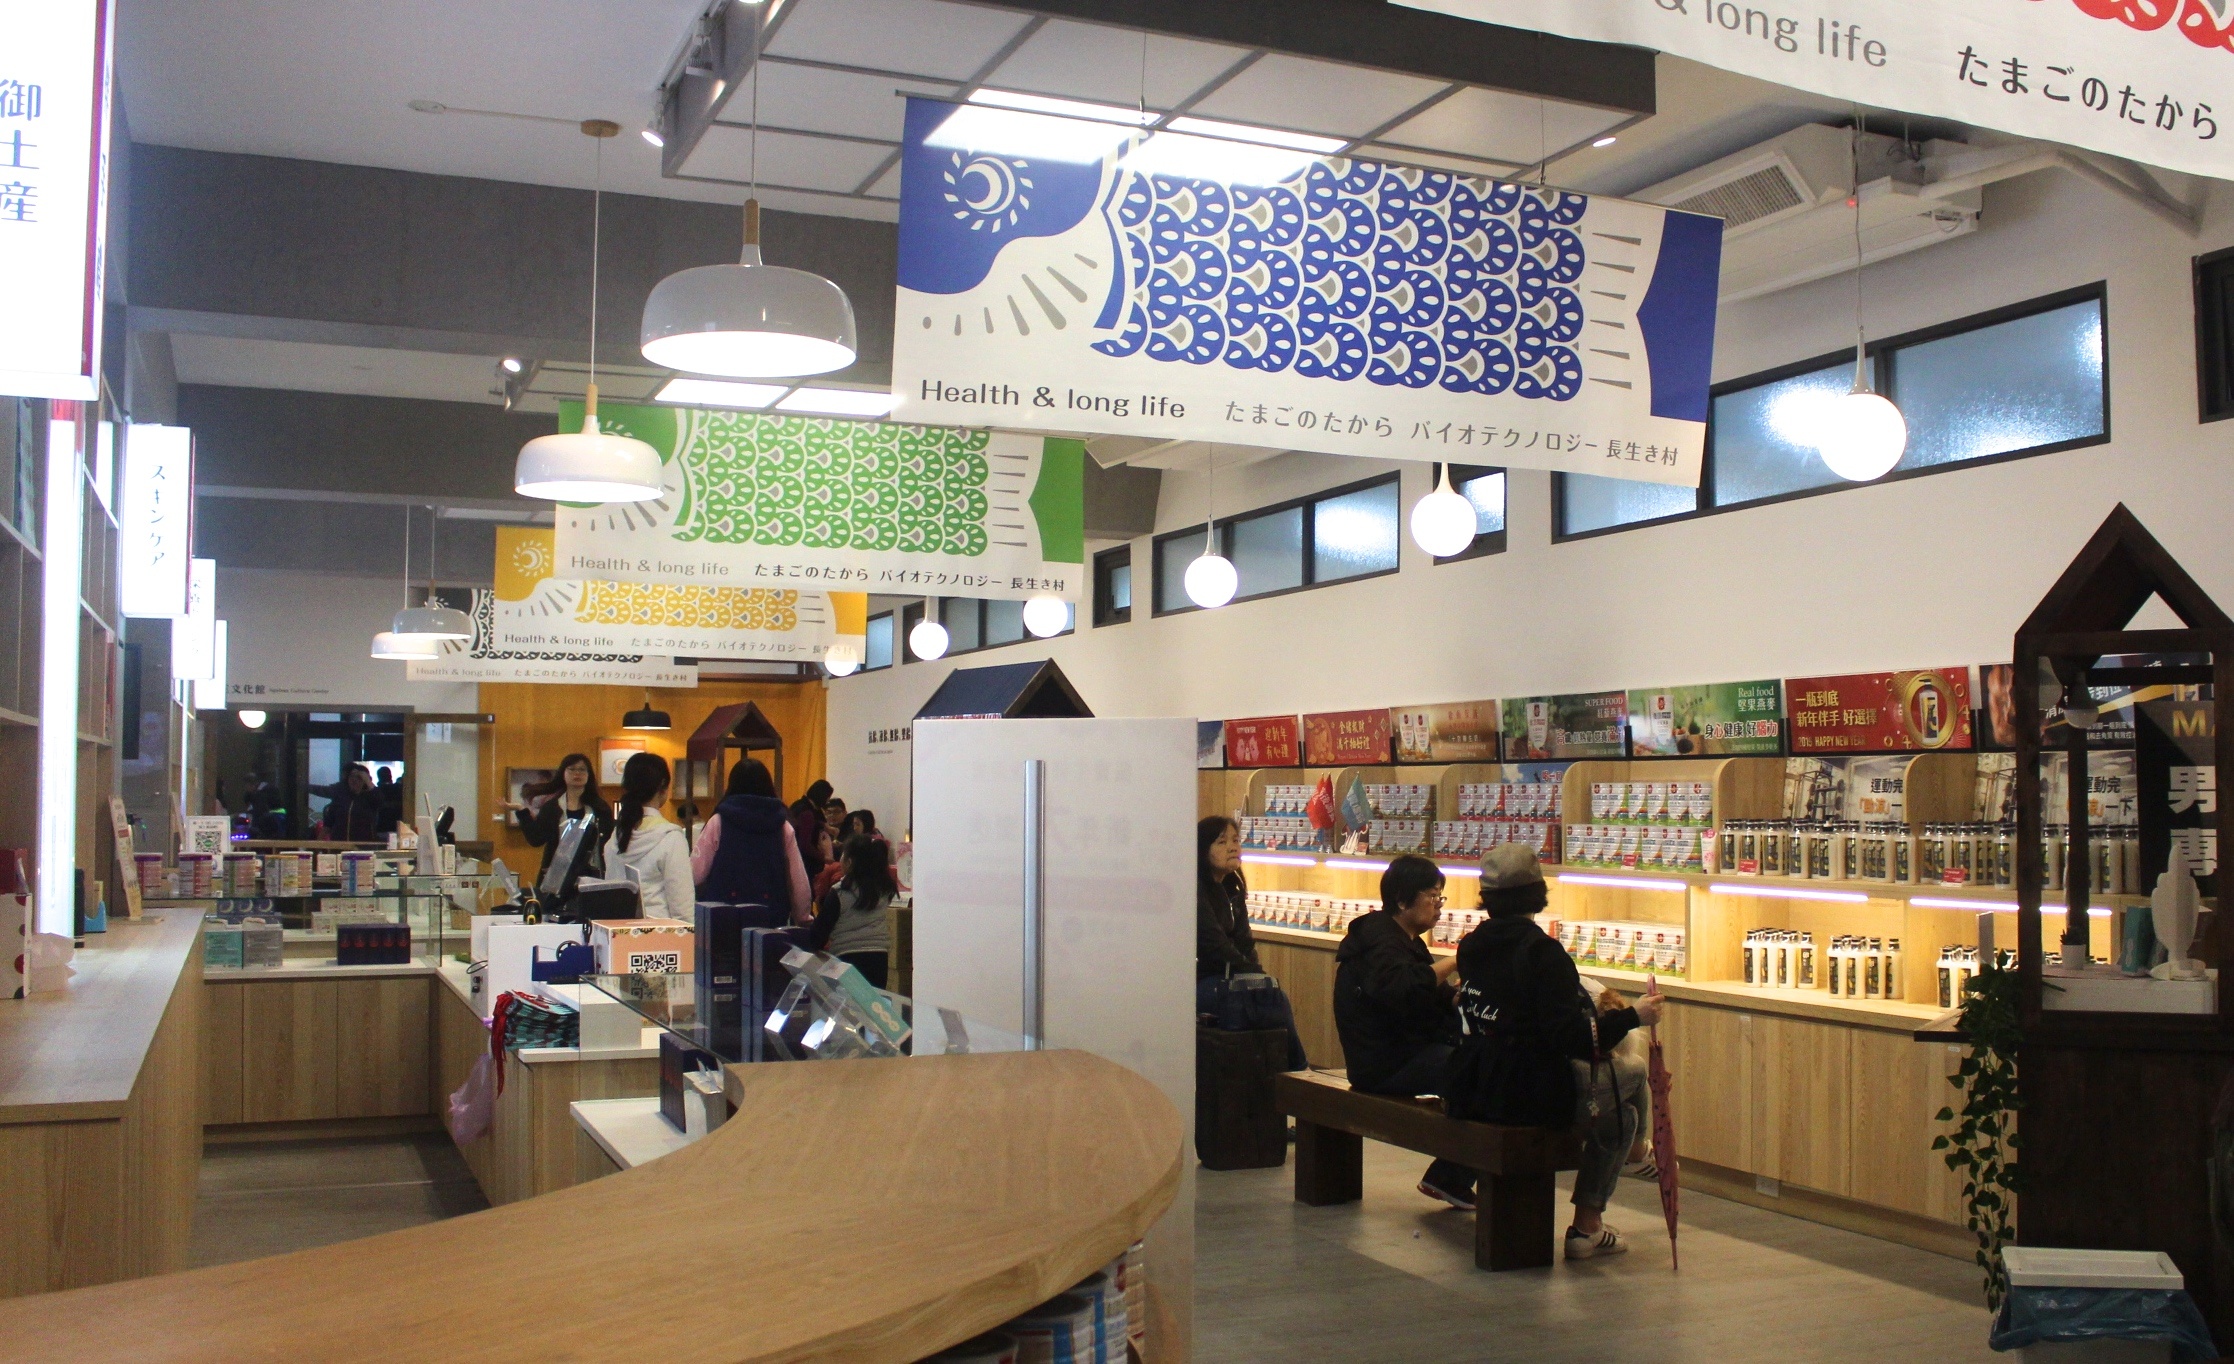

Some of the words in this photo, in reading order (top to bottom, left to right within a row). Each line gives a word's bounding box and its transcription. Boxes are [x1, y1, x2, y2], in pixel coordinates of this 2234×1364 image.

[1706, 0, 1799, 53] long
[1817, 16, 1888, 68] life
[1956, 44, 2219, 142] たまごのたから
[0, 78, 42, 223] 御土産
[921, 379, 1020, 407] Health
[1032, 386, 1056, 408] &
[1068, 388, 1130, 418] long
[1141, 394, 1186, 418] life
[1225, 400, 1394, 438] たまごのたから
[1411, 421, 1598, 454] バイオテクノロジー
[1606, 439, 1679, 467] 長生き村
[150, 465, 166, 566] スキンケア
[571, 556, 631, 574] Health
[637, 557, 652, 573] &
[658, 559, 697, 579] long
[702, 561, 730, 577] life
[754, 562, 870, 582] たまごのたから
[879, 569, 1003, 588] バイオテクノロジー
[1010, 576, 1066, 593] 長生き村
[504, 633, 546, 646] Health
[549, 635, 560, 646] &
[562, 636, 591, 649] long
[593, 636, 614, 648] life
[631, 637, 711, 651] たまごのたから
[717, 640, 808, 654] バイオテクノロジー
[226, 684, 266, 695] 文化館
[1738, 687, 1755, 698] Real
[1756, 686, 1775, 697] food
[1795, 690, 1839, 708] 一瓶到底
[1606, 696, 1624, 706] FOOD
[1738, 697, 1776, 712] 堅果燕麥
[1796, 710, 1840, 728] 新年伴手
[1843, 709, 1878, 726] 好選擇
[2172, 709, 2215, 737] M
[1705, 722, 1744, 739] 身心健康
[1746, 719, 1778, 738] 好腦力
[1815, 736, 1834, 747] HAPPY
[1835, 735, 1850, 746] NEW
[1870, 777, 1904, 794] 運動完
[1481, 1005, 1498, 1021] luck
